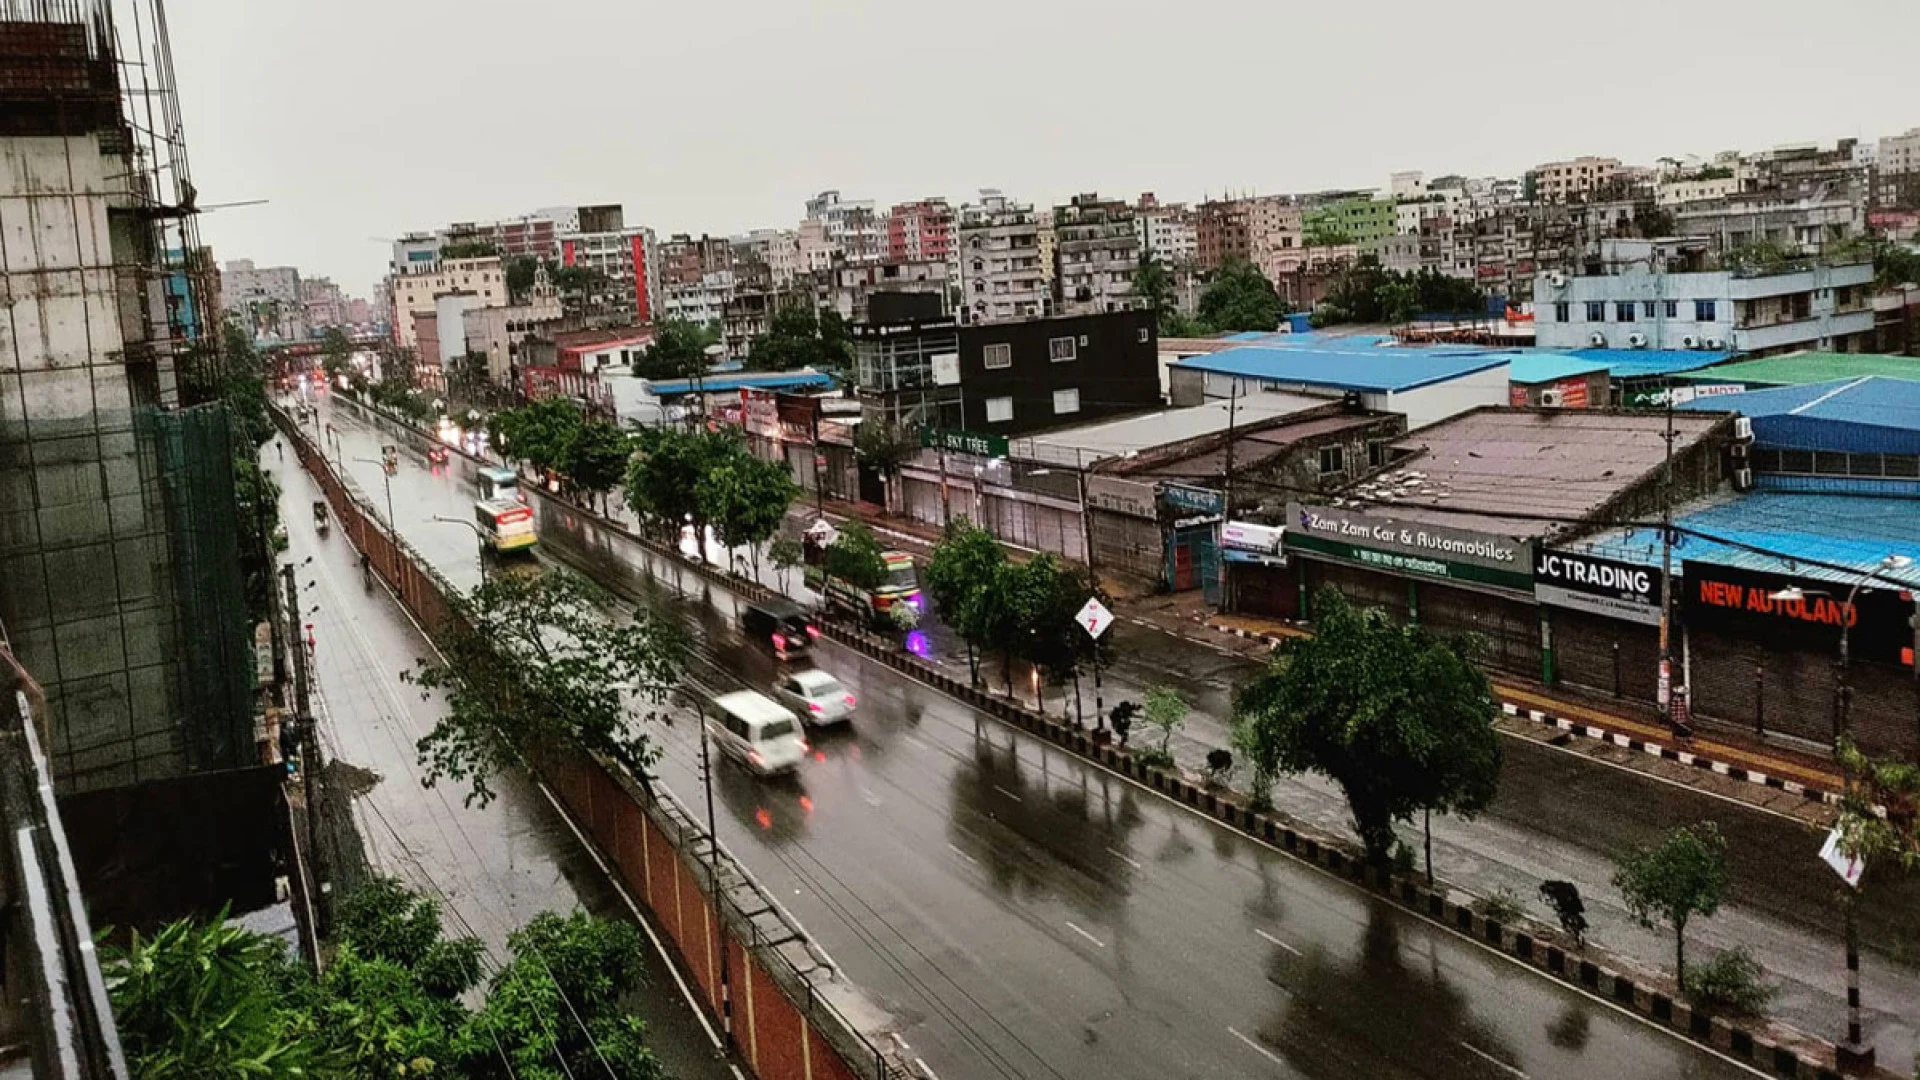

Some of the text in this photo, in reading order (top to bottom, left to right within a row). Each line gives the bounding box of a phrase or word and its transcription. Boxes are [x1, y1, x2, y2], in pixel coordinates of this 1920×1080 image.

[966, 436, 989, 455] TREE
[1310, 513, 1514, 562] Zam Zam Car & Automobiles
[1562, 558, 1651, 594] TRADING
[1700, 579, 1744, 609] NEW
